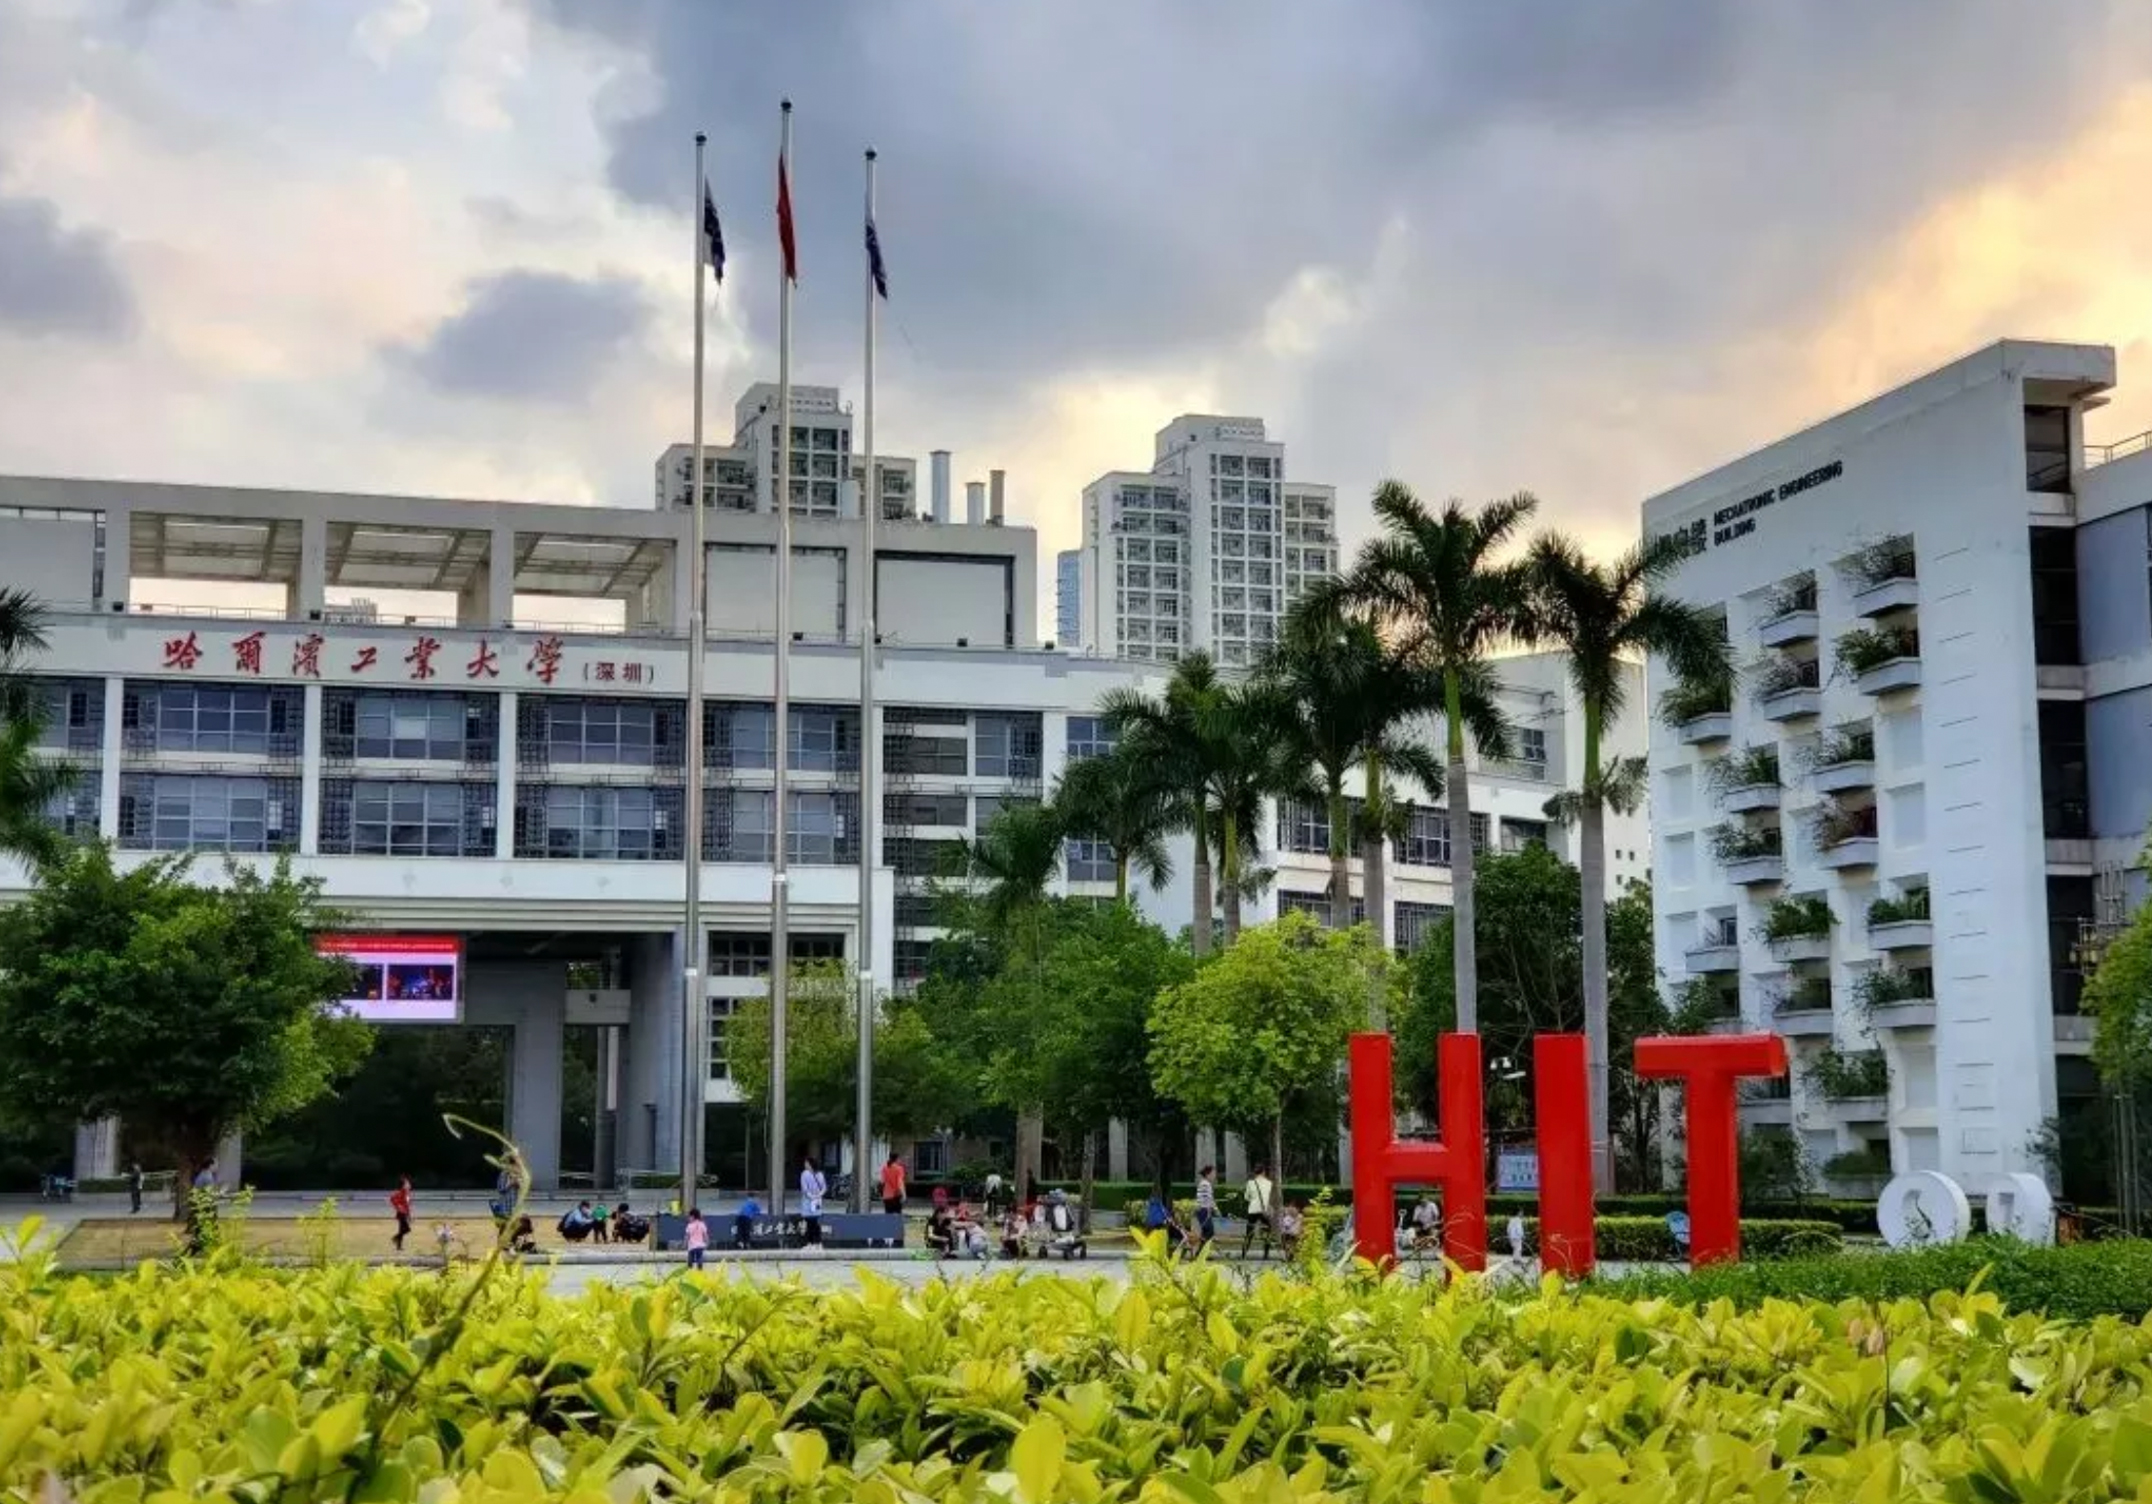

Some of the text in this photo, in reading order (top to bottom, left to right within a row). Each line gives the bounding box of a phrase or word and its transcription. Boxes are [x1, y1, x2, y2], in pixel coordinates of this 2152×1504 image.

[1714, 460, 1843, 526] MECHATRONIC ENGINEERING
[1714, 518, 1756, 546] BUILDING
[1349, 1032, 1787, 1279] HIT
